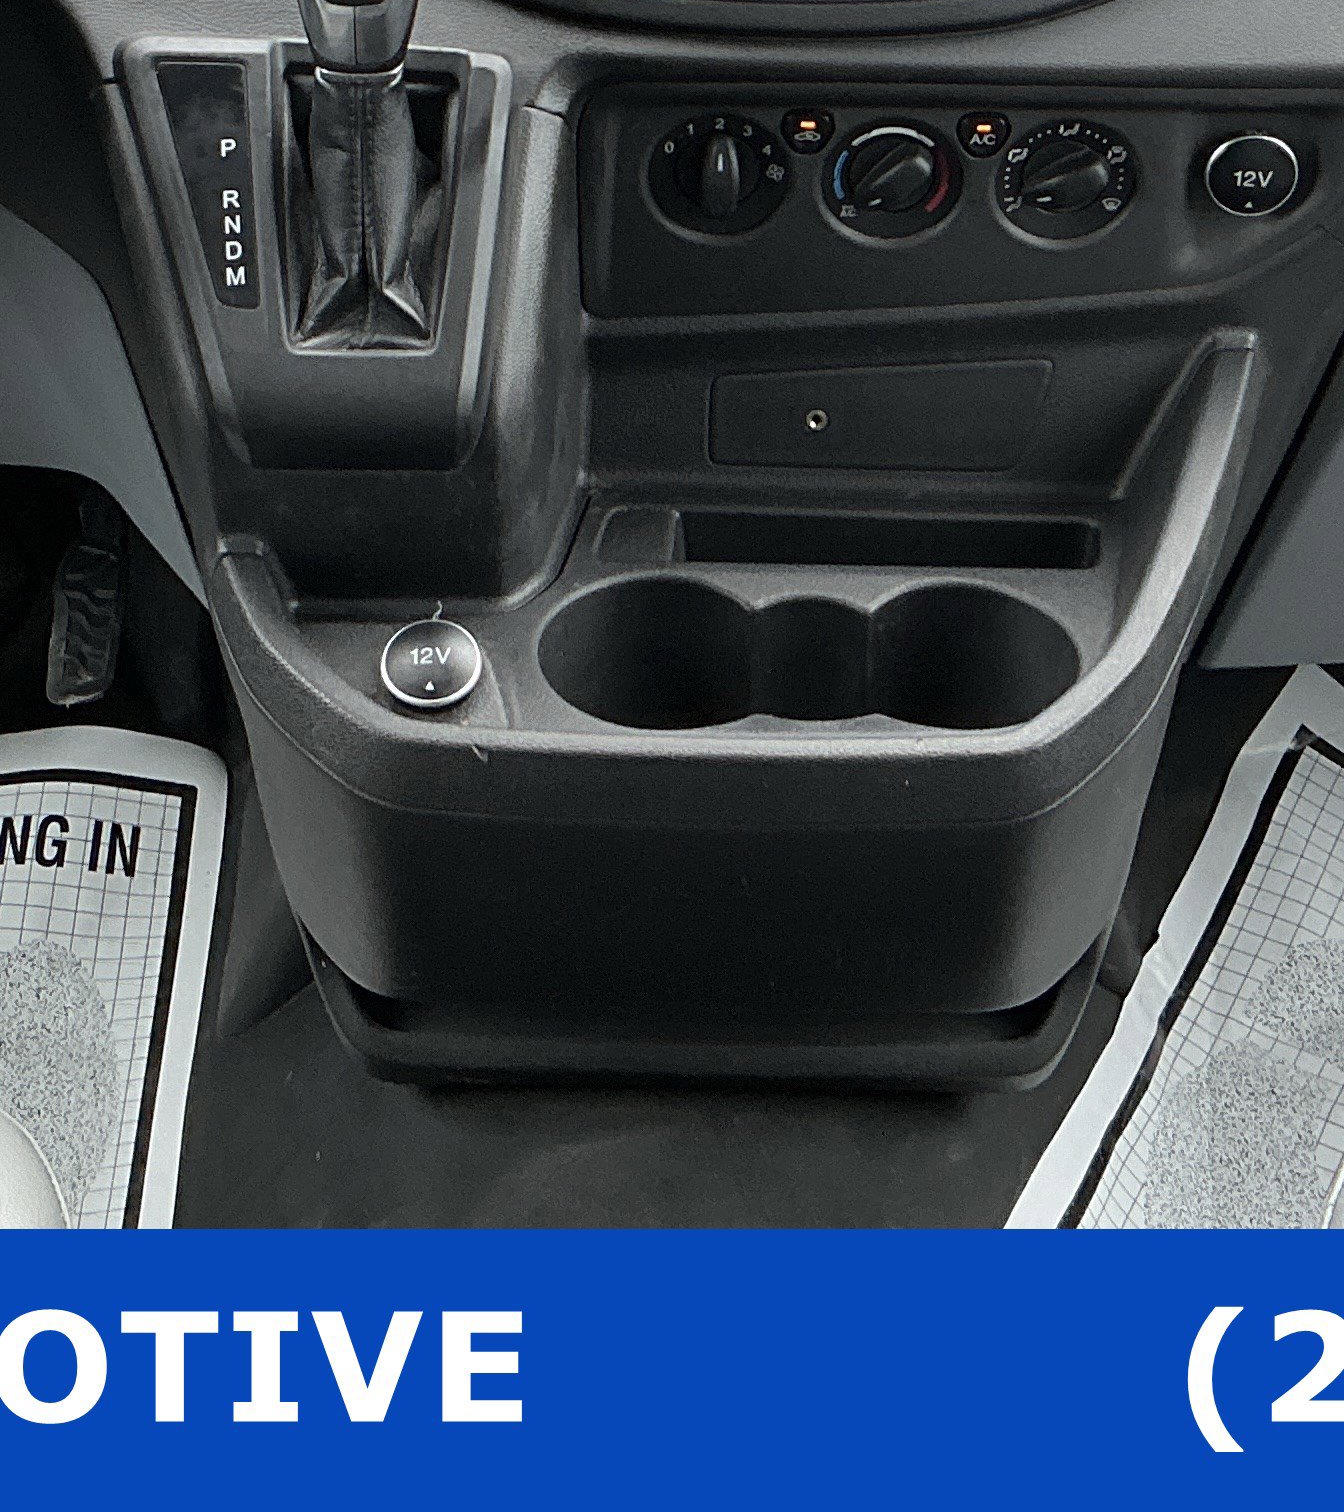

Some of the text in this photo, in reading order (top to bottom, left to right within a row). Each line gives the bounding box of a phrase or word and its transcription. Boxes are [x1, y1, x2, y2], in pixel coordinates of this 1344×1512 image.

[686, 123, 695, 135] 1
[715, 118, 725, 130] 2
[742, 125, 754, 137] 3
[220, 139, 236, 157] P
[664, 141, 675, 154] 0
[970, 134, 997, 147] A/C
[762, 145, 772, 156] 4
[1233, 170, 1274, 188] 12V
[222, 190, 240, 209] R
[224, 215, 241, 235] N
[225, 241, 243, 261] D
[226, 267, 246, 287] M
[409, 646, 452, 665] 12V
[87, 820, 143, 878] IN
